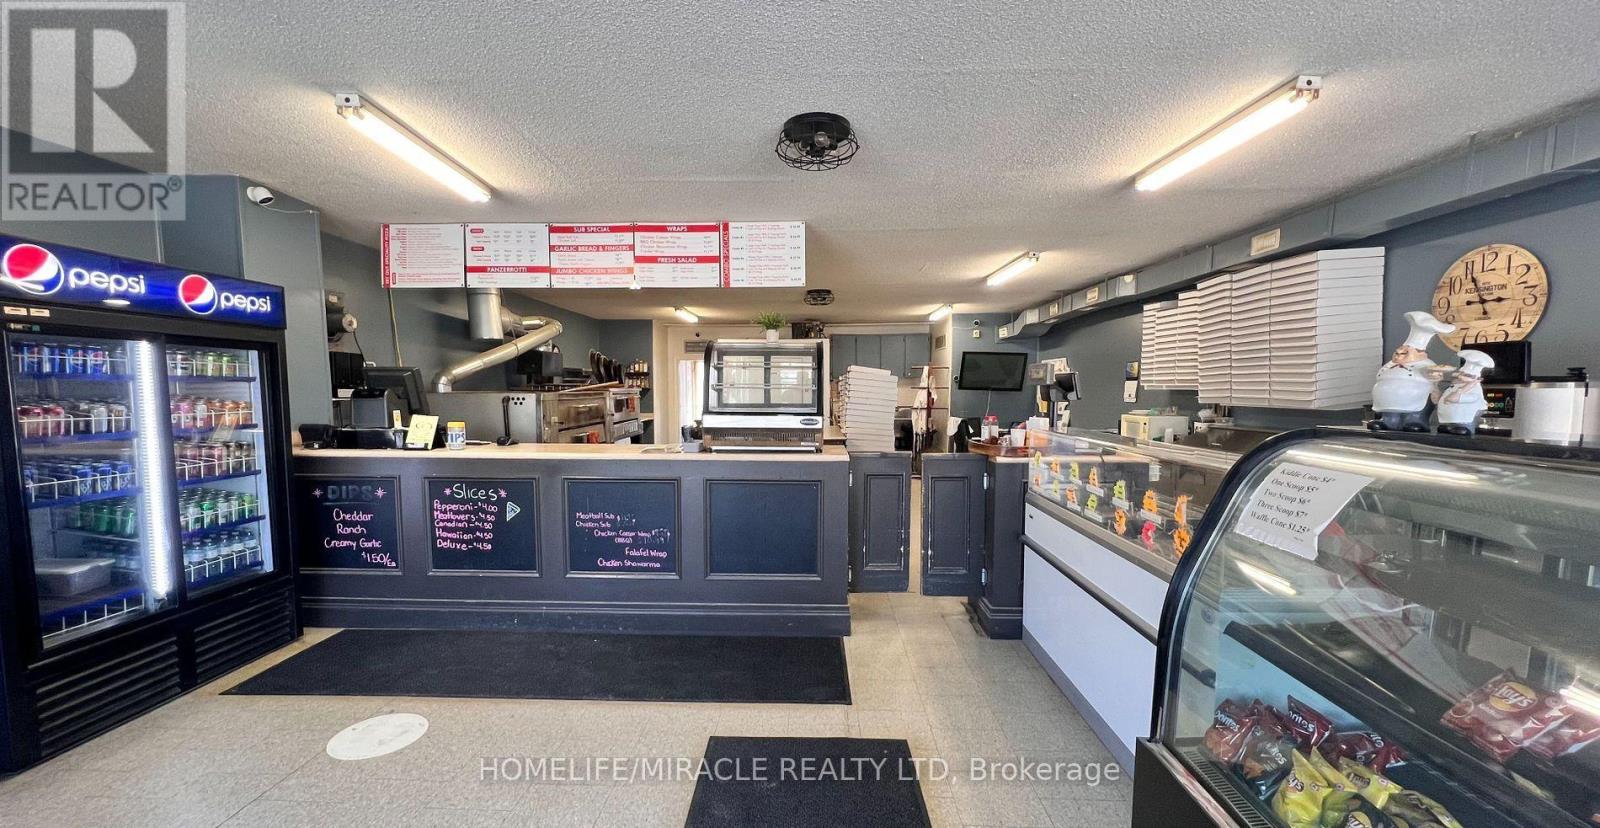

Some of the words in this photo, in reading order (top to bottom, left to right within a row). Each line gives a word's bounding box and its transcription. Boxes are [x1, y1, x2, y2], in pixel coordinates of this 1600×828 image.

[1465, 260, 1475, 280] 11
[1480, 251, 1499, 273] 12
[1506, 254, 1512, 275] 1
[68, 267, 146, 295] pepsi
[1515, 263, 1531, 286] 2
[1448, 276, 1462, 296] 10
[1522, 284, 1539, 306] 3
[220, 292, 272, 313] pepsi
[1437, 296, 1450, 315] 9
[1510, 307, 1523, 329] 4
[1460, 327, 1470, 345] 7
[1494, 323, 1509, 342] 5
[1271, 477, 1284, 487] One
[1285, 480, 1305, 492] Scoop
[1302, 472, 1320, 481] Cone
[327, 485, 372, 500] DIPS
[452, 483, 498, 501] Slices
[1264, 488, 1276, 497] Two
[1278, 491, 1296, 503] Scoop
[333, 508, 374, 521] Cheddar
[576, 512, 604, 520] Meatball
[1257, 499, 1274, 510] Three
[1276, 505, 1294, 517] Scoop
[336, 522, 367, 534] Ranch
[1250, 510, 1269, 522] Waffle
[1270, 517, 1288, 529] Cone
[593, 529, 617, 537] Chicken
[324, 537, 356, 551] Creamy
[359, 537, 382, 548] Garlic
[625, 547, 649, 557] Falafel
[650, 550, 668, 559] Wrap
[597, 557, 622, 567] Chicken
[624, 559, 661, 568] Shawarma
